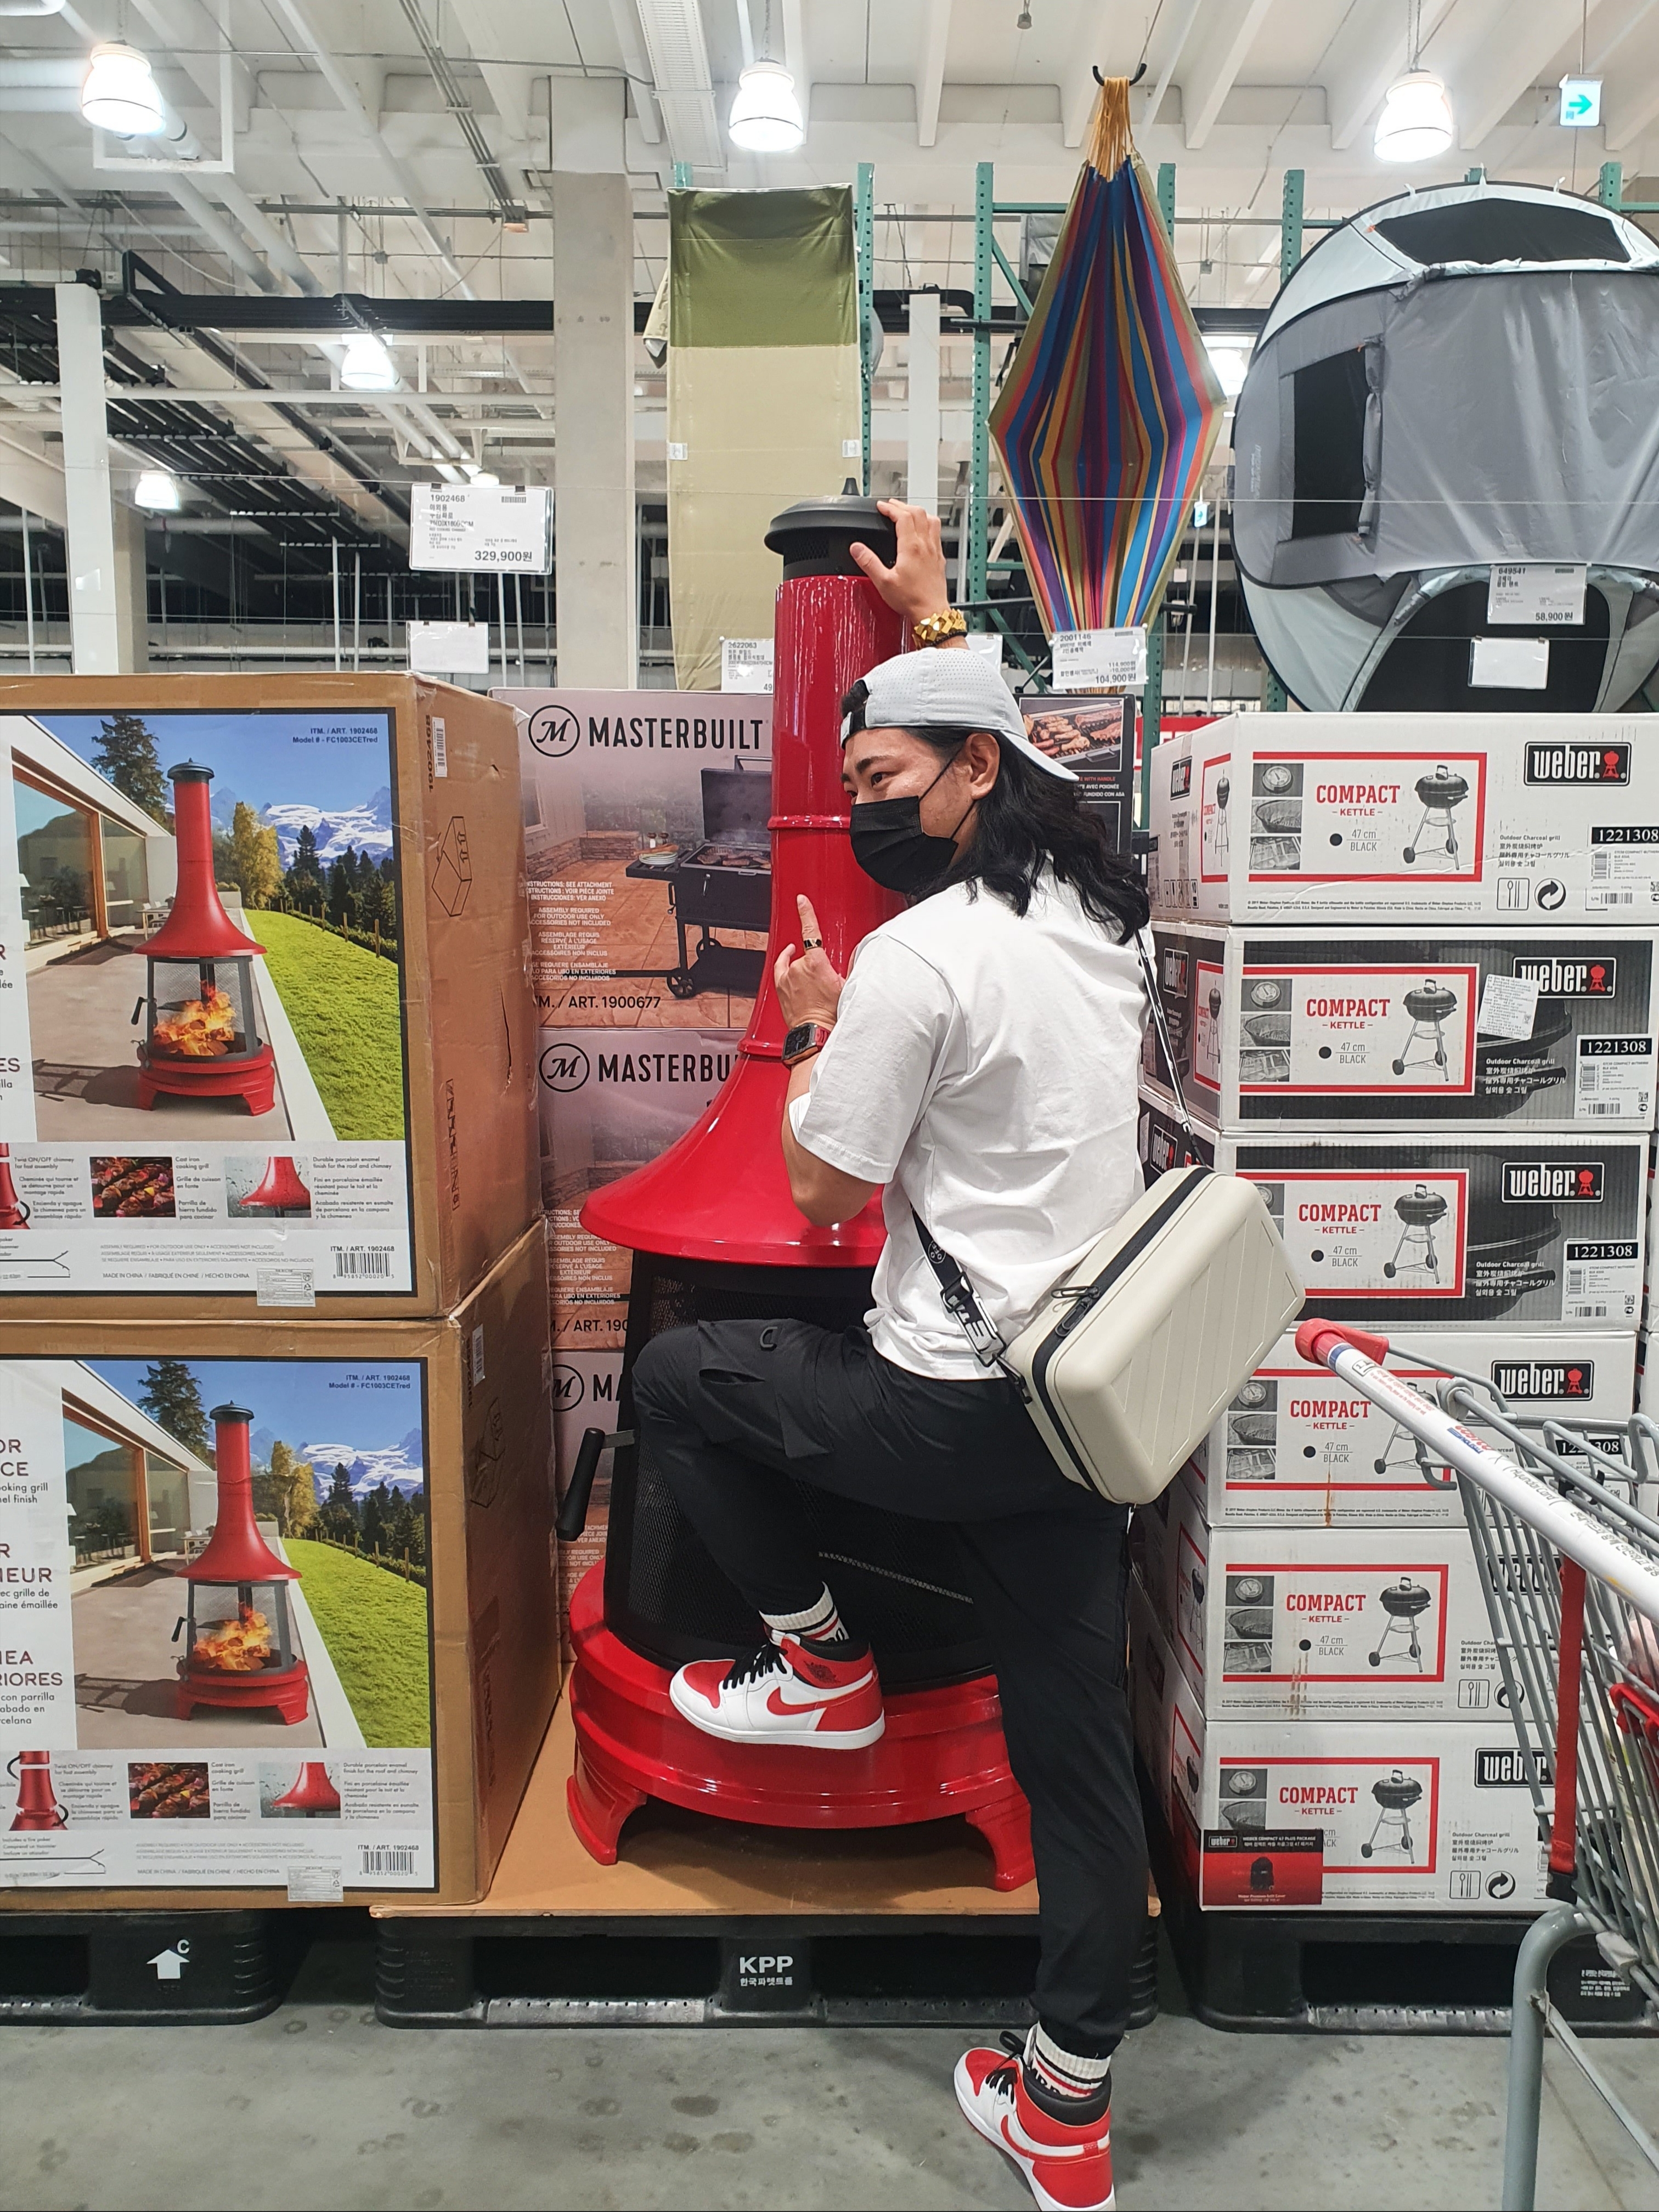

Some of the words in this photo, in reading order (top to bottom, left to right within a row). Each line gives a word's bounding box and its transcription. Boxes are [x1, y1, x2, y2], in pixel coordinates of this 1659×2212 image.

[475, 551, 532, 562] 329,900원
[1096, 674, 1136, 684] 104,900원
[589, 717, 763, 749] MASTERBUILT
[1534, 744, 1600, 779] weber
[1316, 785, 1401, 804] COMPACT
[1352, 829, 1361, 838] 47
[1599, 830, 1658, 842] 1221308
[1351, 842, 1377, 852] BLACK
[568, 996, 598, 1008] ART.
[602, 996, 661, 1008] 1900677
[1307, 998, 1390, 1017] COMPACT
[1341, 1042, 1351, 1052] 47
[1588, 1041, 1646, 1053] 1221308
[1339, 1054, 1366, 1064] BLACK
[599, 1054, 738, 1082] MASTERBU
[1510, 1164, 1575, 1197] weber
[1299, 1204, 1381, 1222] COMPACT
[1333, 1246, 1342, 1255] 47
[1574, 1245, 1633, 1258] 1221308
[1332, 1258, 1358, 1267] BLACK
[1500, 1363, 1564, 1395] weber
[1290, 1401, 1371, 1418] COMPACT
[1324, 1442, 1334, 1451] 47
[1324, 1454, 1349, 1463] BLACK
[30, 1482, 48, 1492] grill
[14, 1495, 38, 1504] finish
[14, 1589, 35, 1598] grille
[21, 1600, 58, 1609] émaillée
[1286, 1594, 1367, 1611] COMPACT
[1320, 1635, 1329, 1644] 47
[1318, 1647, 1344, 1656] BLACK
[21, 1692, 55, 1703] parrilla
[1483, 1750, 1547, 1781] webr
[1279, 1787, 1358, 1804] COMPACT
[1301, 1807, 1335, 1815] KETTLE
[1211, 1836, 1230, 1846] weber
[177, 1939, 190, 1955] C
[740, 1956, 793, 1973] KPP
